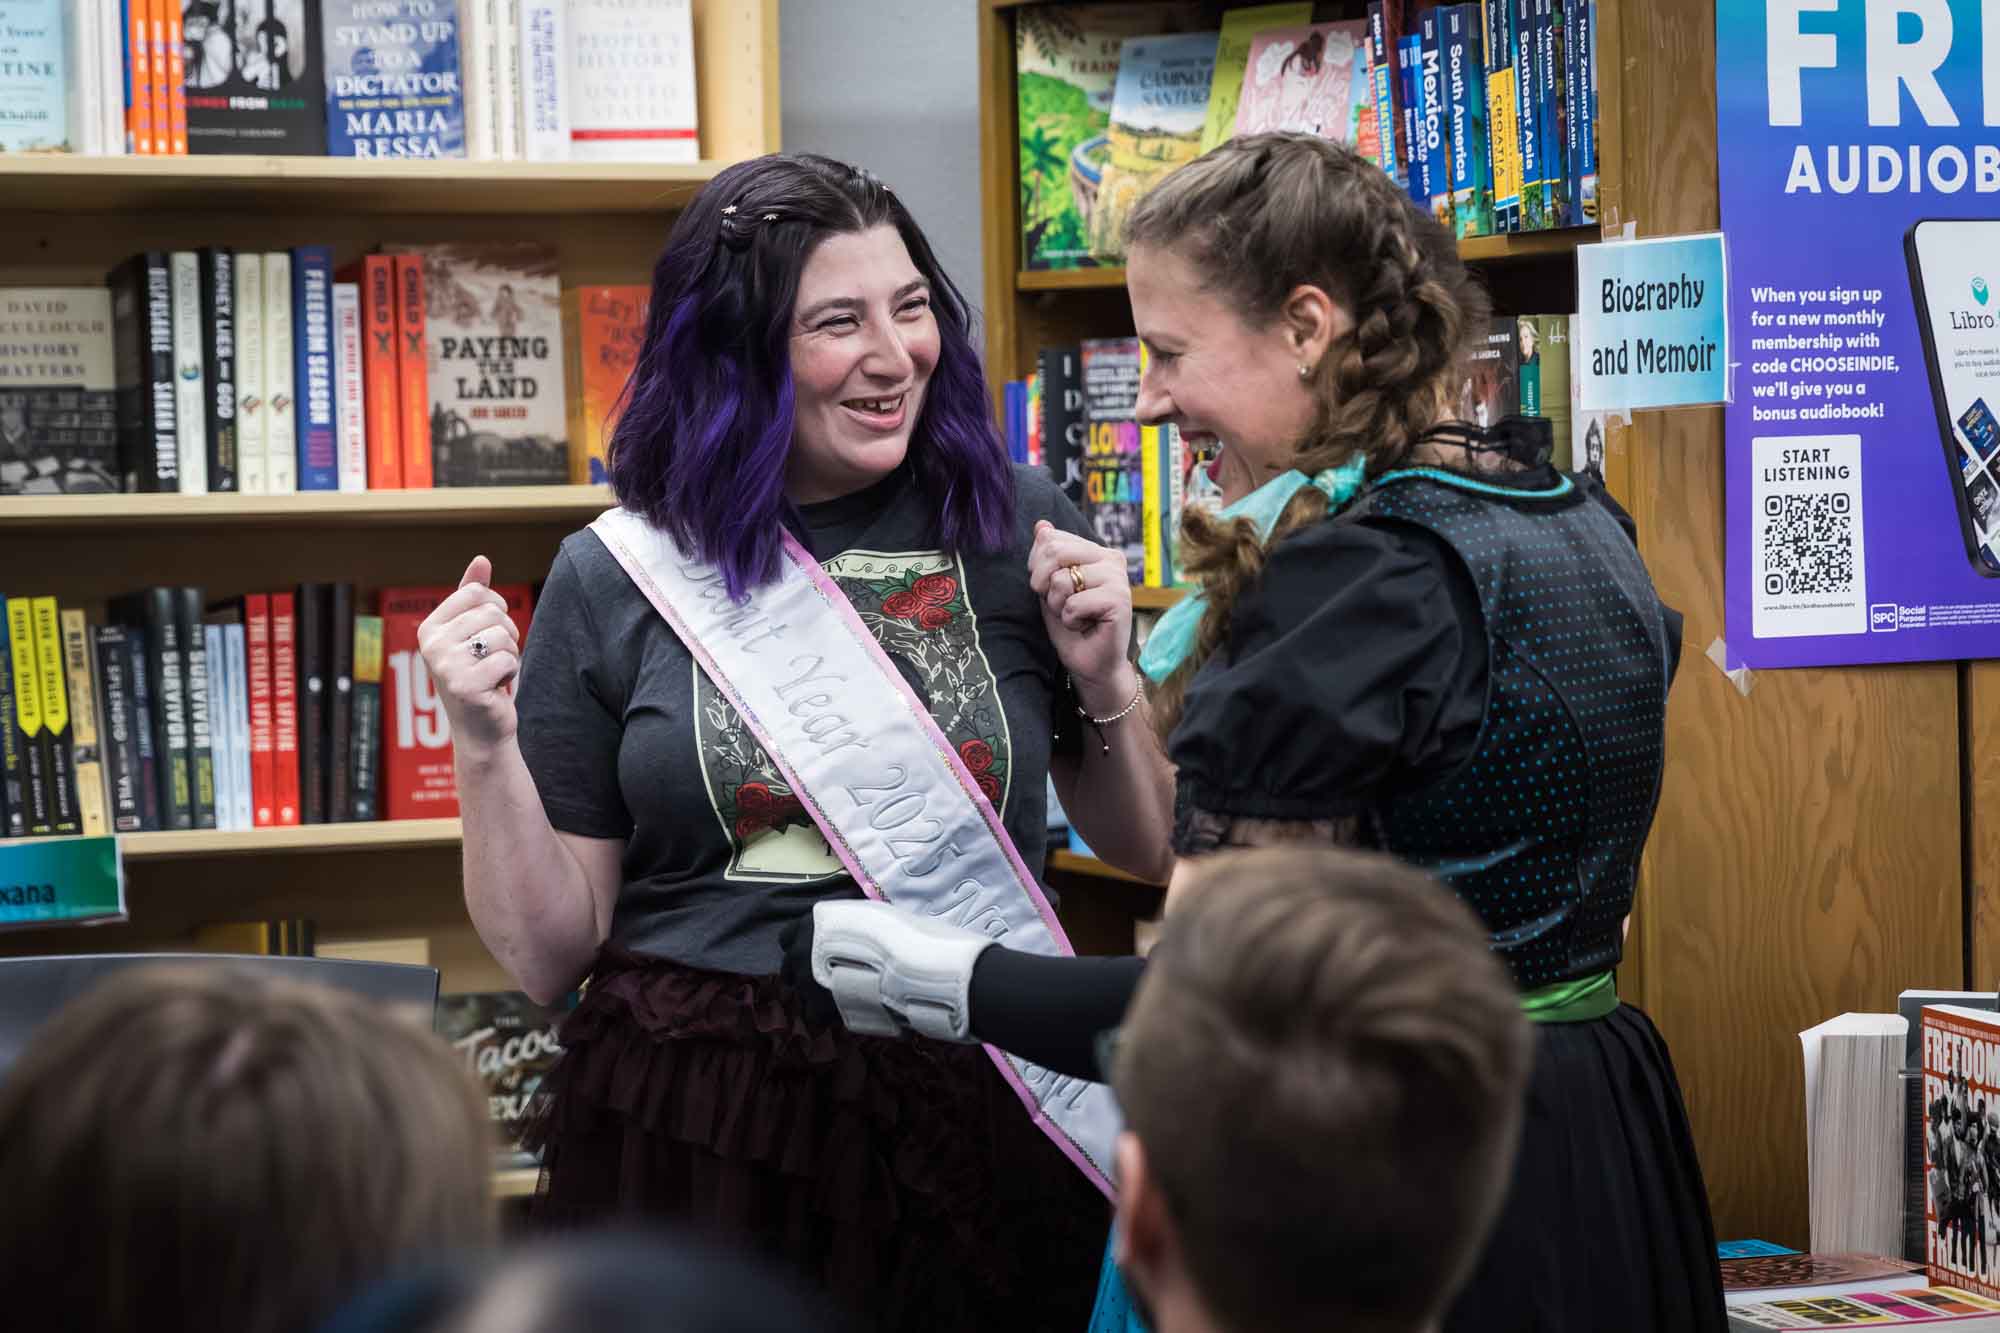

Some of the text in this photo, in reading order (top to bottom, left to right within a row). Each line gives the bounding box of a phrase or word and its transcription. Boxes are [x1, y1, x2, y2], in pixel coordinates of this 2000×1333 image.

[352, 0, 434, 18] HOW TO
[335, 21, 454, 44] STAND UP
[1579, 18, 1588, 55] New
[576, 52, 680, 68] HISTORY
[1450, 43, 1464, 100] South
[1545, 25, 1554, 89] Vietnam
[1765, 0, 2000, 127] FR
[336, 71, 459, 97] DICTATOR
[586, 85, 678, 101] UNITED
[1520, 30, 1532, 126] Southeast
[1580, 57, 1590, 120] Zealand
[1375, 70, 1393, 168] USA NATIONAL
[1422, 49, 1441, 150] Mexico
[345, 110, 449, 136] MARIA
[1452, 103, 1466, 182] America
[1495, 94, 1505, 178] CROATIA
[355, 138, 442, 160] RESSA
[1524, 129, 1534, 170] Asia
[1421, 164, 1431, 196] RICA
[7, 302, 69, 314] DAVID
[148, 266, 172, 353] DISPOSABLE
[304, 269, 328, 353] FREEDOM
[373, 266, 391, 353] CHILD X
[404, 266, 423, 353] CHILD X
[1601, 272, 1705, 314] Biography
[1751, 286, 1882, 306] When you sign up
[1751, 309, 1885, 327] for a new monthly
[440, 336, 549, 359] PAYING
[1592, 336, 1717, 377] and Memoir
[1751, 331, 1881, 352] membership with
[476, 359, 515, 374] THE
[1751, 355, 1900, 374] code CHOOSEINDIE,
[216, 382, 234, 419] GOD
[307, 354, 330, 424] SEASON
[456, 378, 538, 400] LAND
[1752, 381, 1866, 400] we'll give you a
[153, 380, 178, 480] SARAH JONES
[1752, 403, 1885, 421] bonus audiobook!
[1764, 466, 1850, 482] LISTENING
[1782, 448, 1831, 464] START
[1873, 612, 1896, 624] SPC
[1899, 605, 1927, 616] Social
[162, 650, 187, 749] SURVIVOR
[189, 650, 209, 749] SURVIVOR
[106, 663, 128, 742] SPLENDID
[117, 775, 135, 810] VILE
[771, 653, 872, 757] Year
[845, 763, 965, 878] 2025
[451, 1025, 568, 1074] Tacos
[1924, 1024, 2000, 1089] FREEDOM
